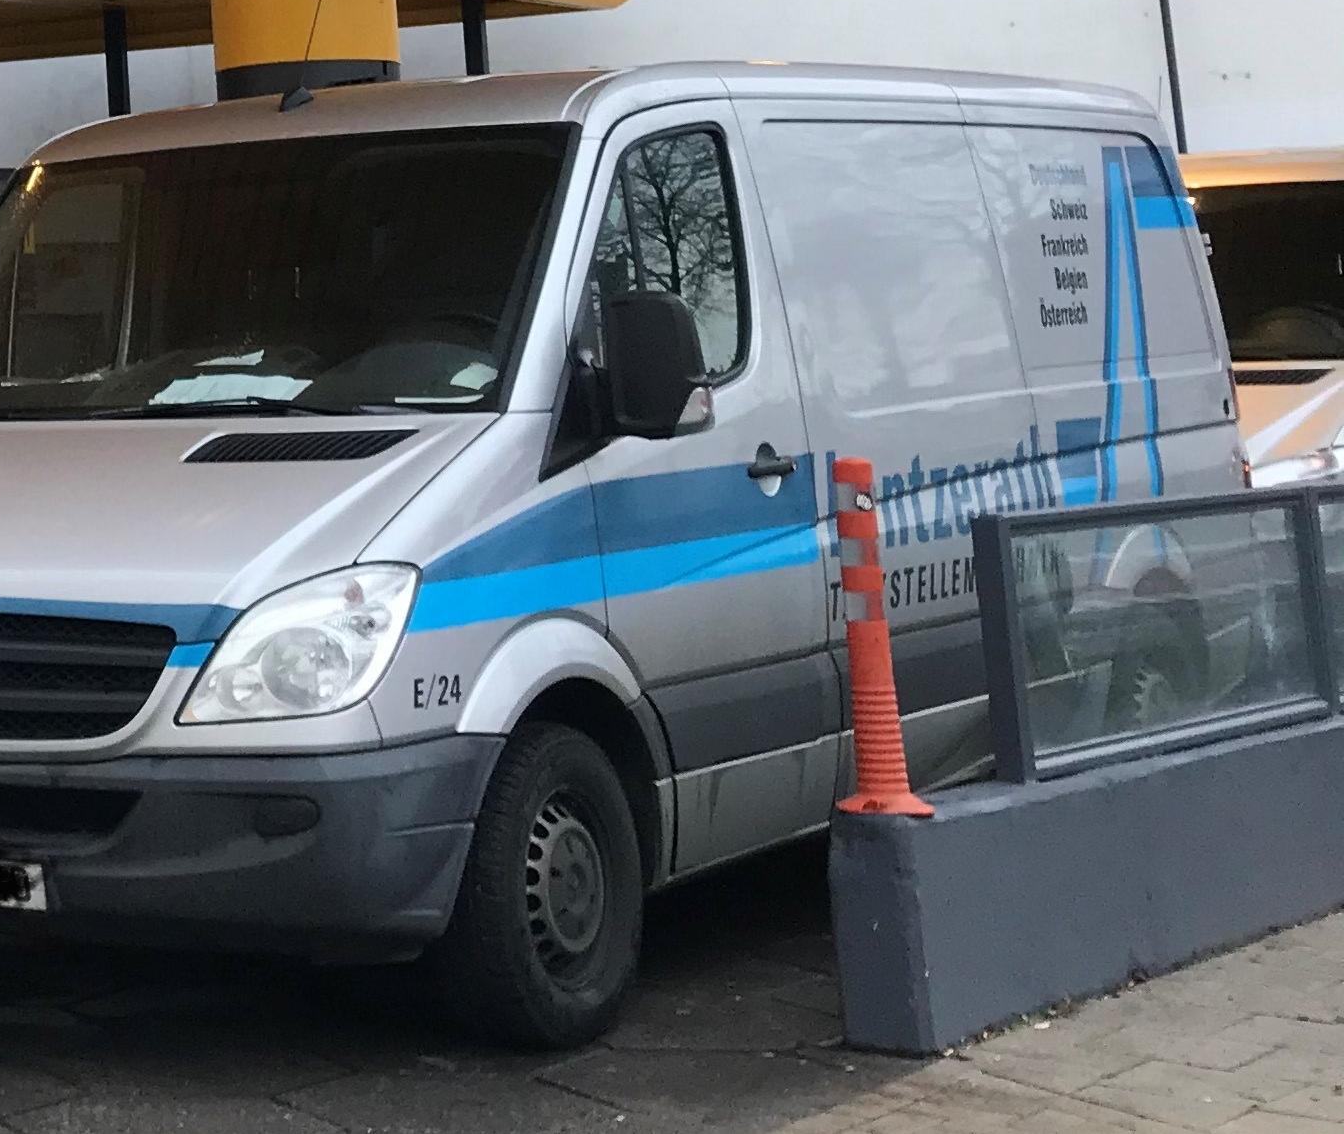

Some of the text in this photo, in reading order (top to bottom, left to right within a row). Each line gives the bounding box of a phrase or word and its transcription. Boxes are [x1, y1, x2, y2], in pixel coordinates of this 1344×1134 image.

[1050, 198, 1088, 220] Schweiz
[1041, 234, 1088, 257] Frankreich
[1054, 267, 1088, 294] Belgien
[1040, 297, 1088, 328] Österreich
[826, 424, 1056, 558] Lntzerath
[413, 674, 461, 710] E/24
